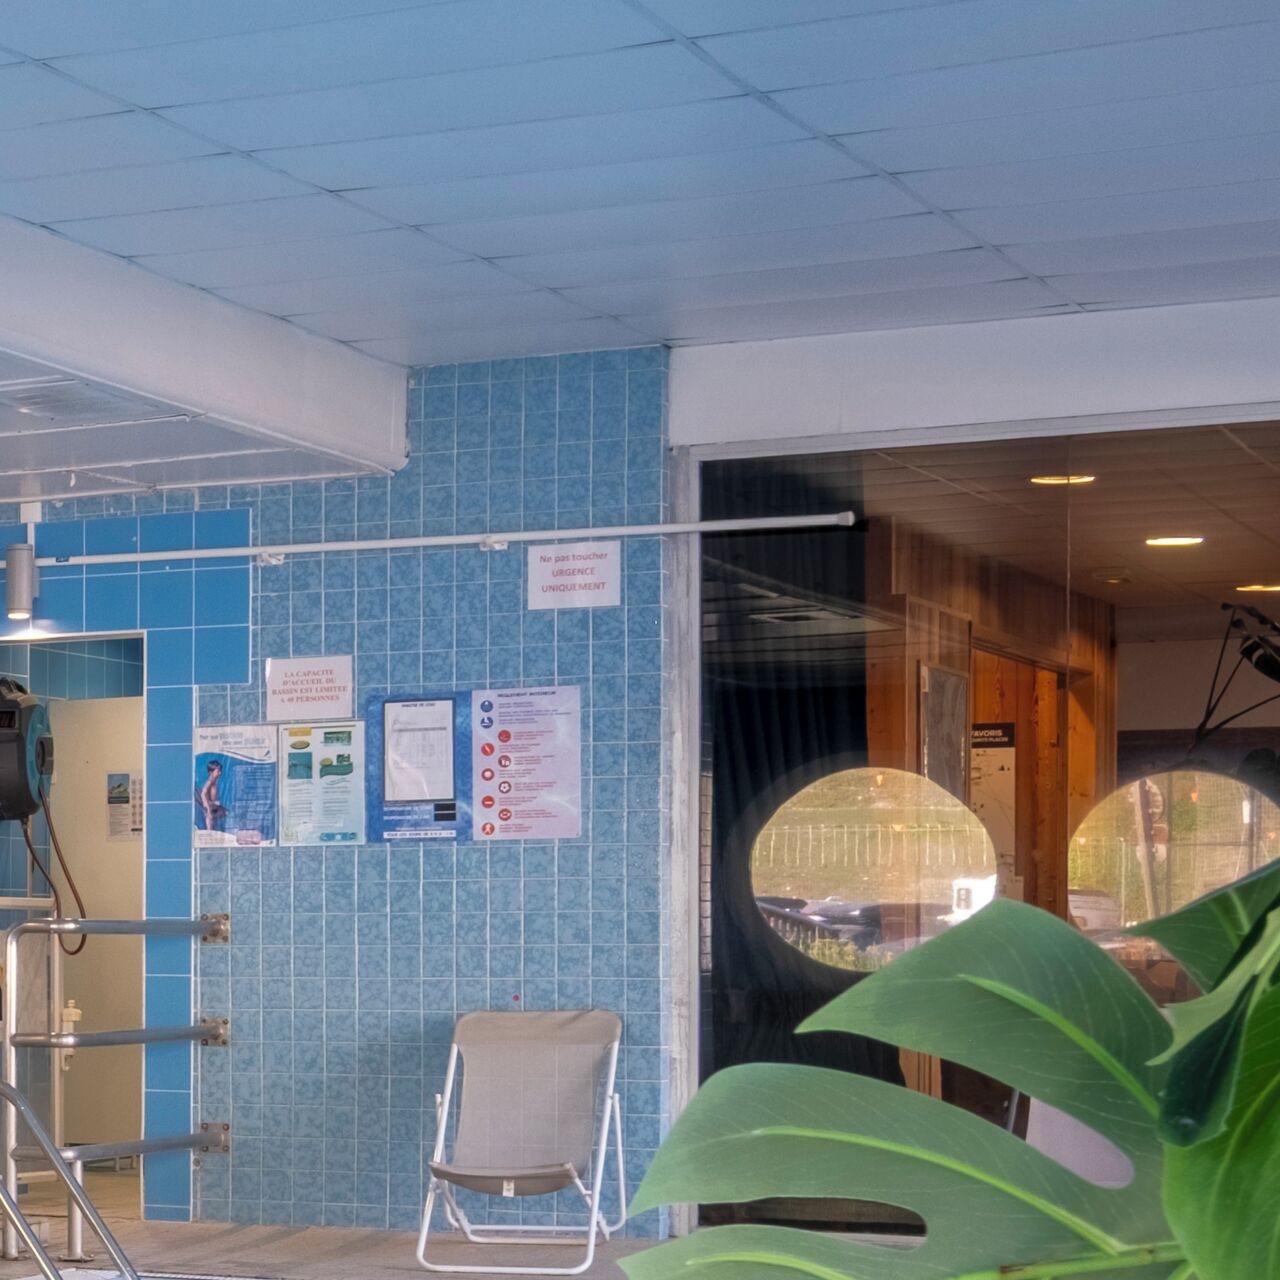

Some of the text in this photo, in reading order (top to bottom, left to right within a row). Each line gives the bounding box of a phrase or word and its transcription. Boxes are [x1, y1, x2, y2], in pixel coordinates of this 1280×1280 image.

[540, 552, 608, 564] Ne pas toucher
[552, 567, 596, 577] URGENCE
[541, 581, 607, 593] UNIQUEMENT
